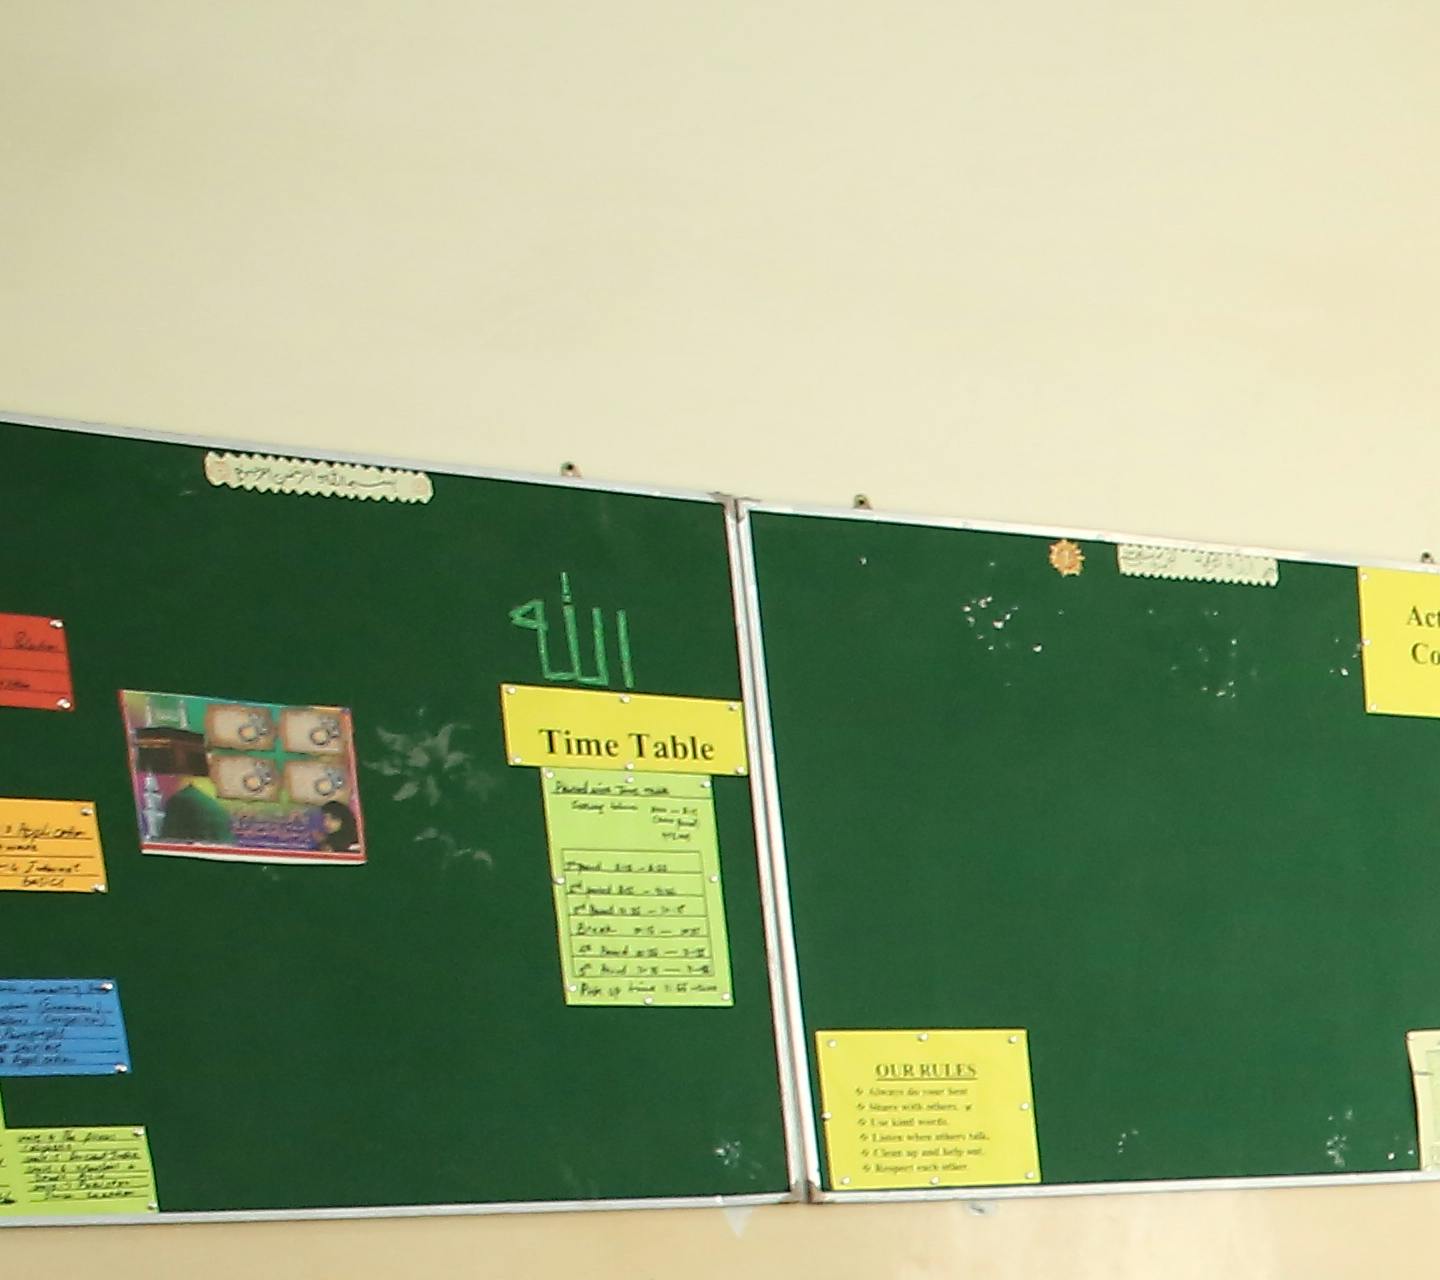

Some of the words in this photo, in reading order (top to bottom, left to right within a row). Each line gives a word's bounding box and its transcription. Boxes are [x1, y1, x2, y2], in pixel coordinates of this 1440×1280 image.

[537, 728, 619, 757] Time
[627, 732, 715, 761] Table
[875, 1063, 914, 1077] OUR
[920, 1062, 977, 1077] RULES
